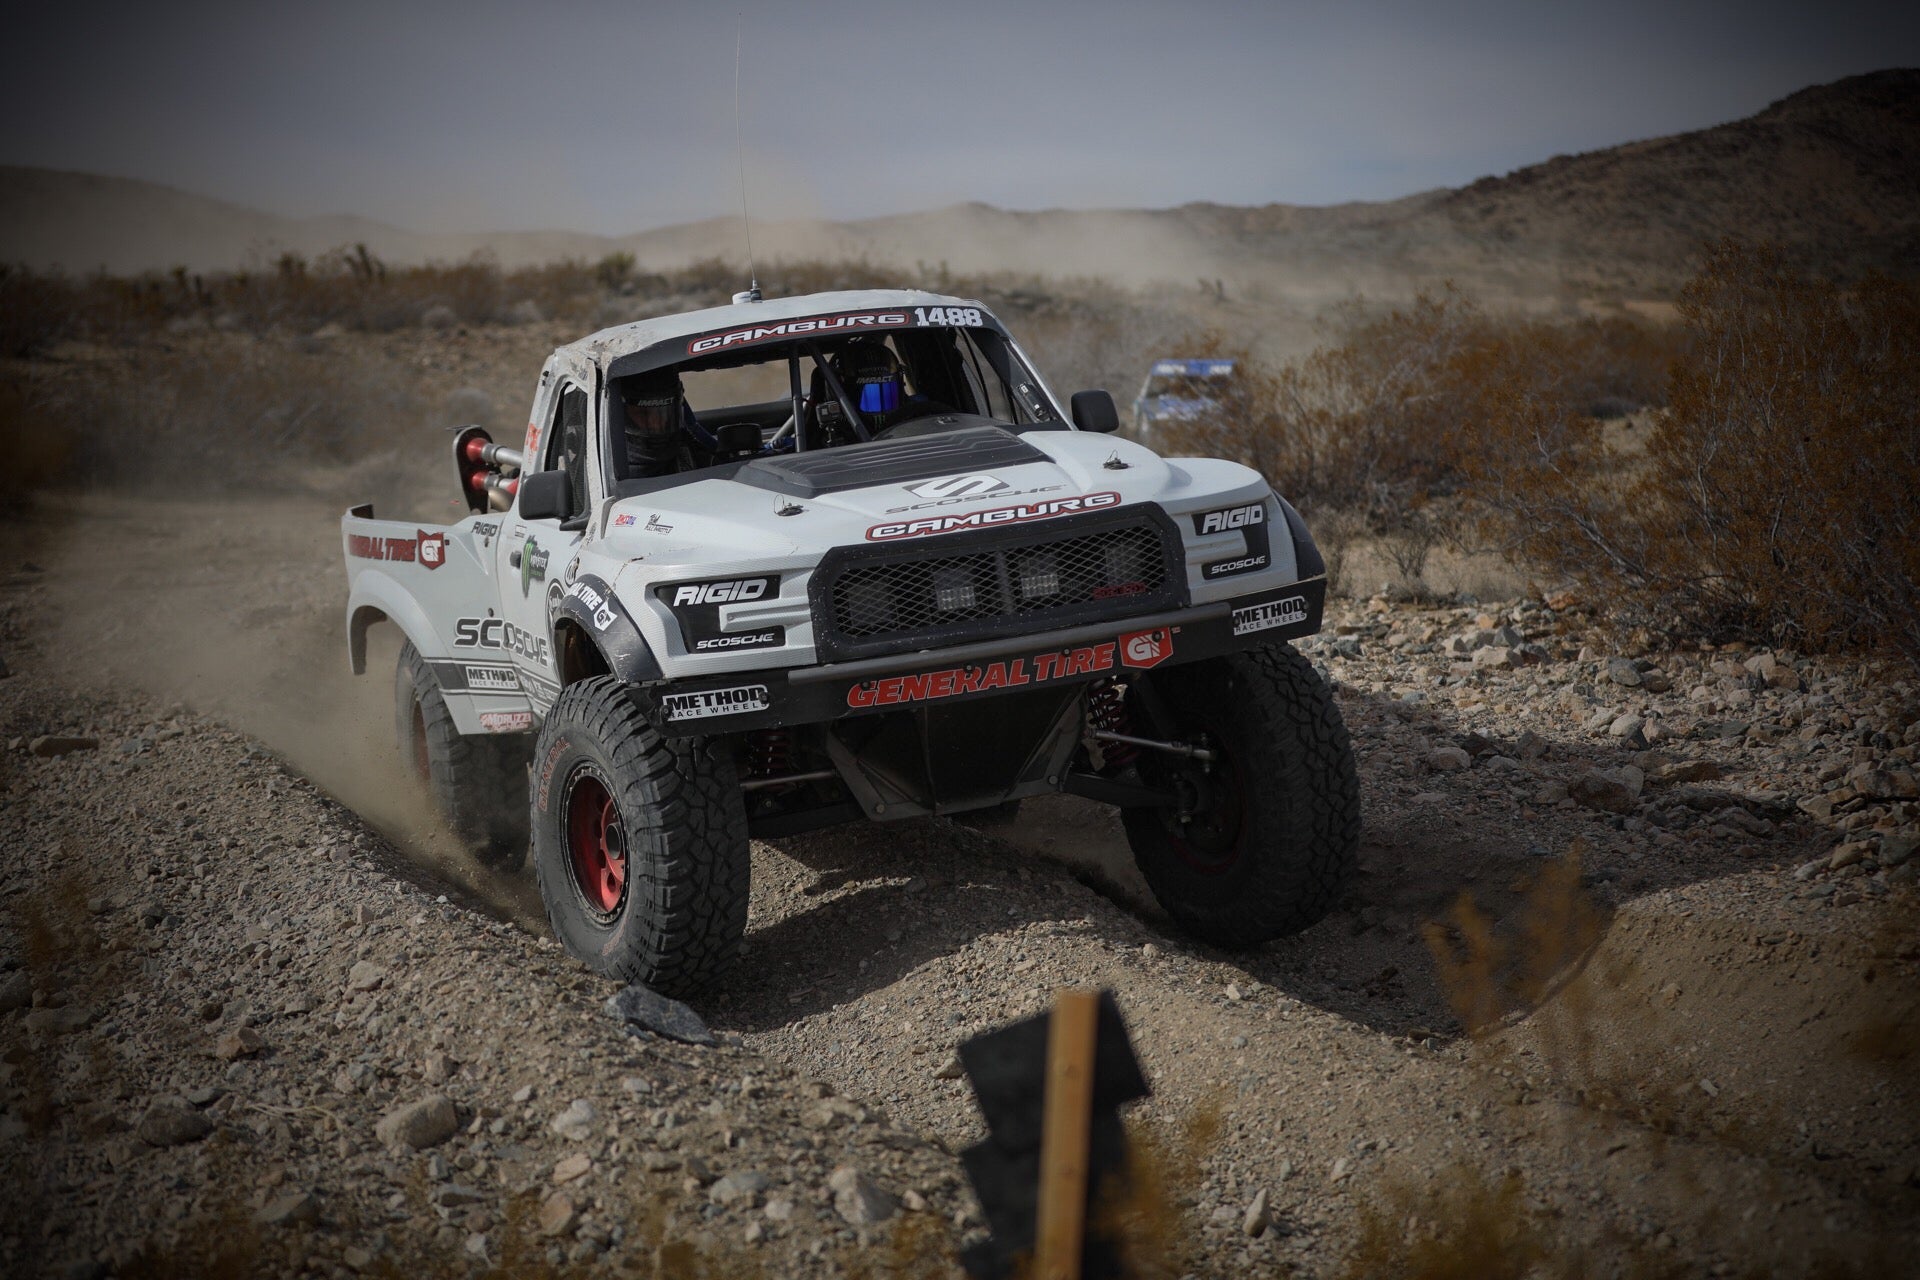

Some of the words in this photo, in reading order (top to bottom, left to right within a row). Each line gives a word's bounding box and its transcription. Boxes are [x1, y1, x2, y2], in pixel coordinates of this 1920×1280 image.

[914, 307, 984, 327] 1488
[691, 313, 906, 353] CAMBURG
[885, 484, 1066, 515] SCOSCHE
[872, 491, 1117, 539] CAMBURG
[1202, 504, 1264, 535] RIGID
[471, 521, 498, 537] RIGID
[384, 537, 417, 562] TIRE
[1210, 555, 1267, 575] SCOSCHE
[578, 585, 603, 612] TIRE
[673, 578, 768, 607] RIGID
[1235, 598, 1305, 625] METHOD
[1235, 621, 1261, 633] RACE
[1267, 612, 1305, 626] WHEELS
[454, 617, 549, 668] SCOSCHE
[696, 632, 776, 650] SCOSCHE
[468, 668, 516, 682] METHOD
[847, 657, 1031, 709] GENERAL
[1033, 642, 1116, 682] TIRE
[666, 687, 766, 711] METHOD
